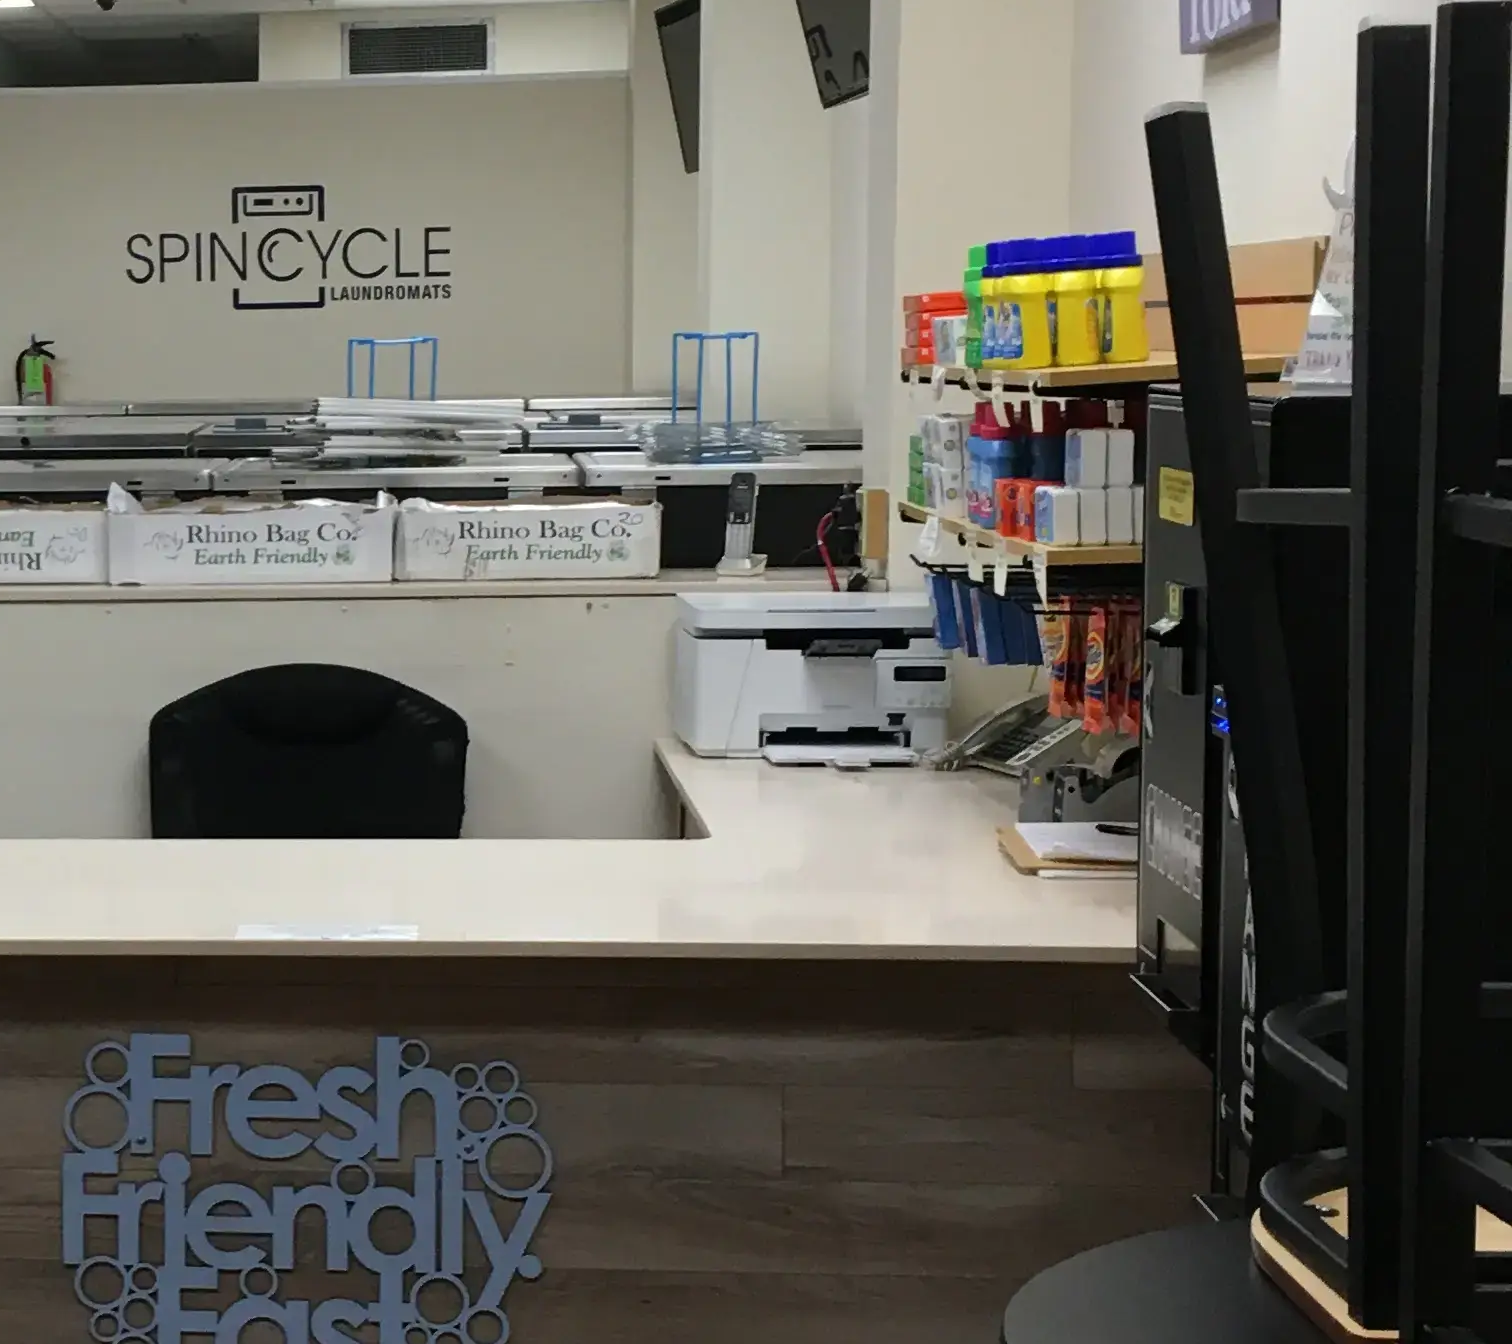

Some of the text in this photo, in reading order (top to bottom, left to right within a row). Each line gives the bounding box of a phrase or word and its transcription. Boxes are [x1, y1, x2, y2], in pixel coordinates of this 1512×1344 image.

[329, 283, 453, 302] LAUNDROMATS
[185, 522, 359, 548] Rhino Bag Co.
[458, 518, 633, 543] Rhino Bag Co.
[193, 545, 329, 568] Earth Friendly
[465, 542, 603, 564] Earth Friendly
[129, 1032, 461, 1160] Fresh
